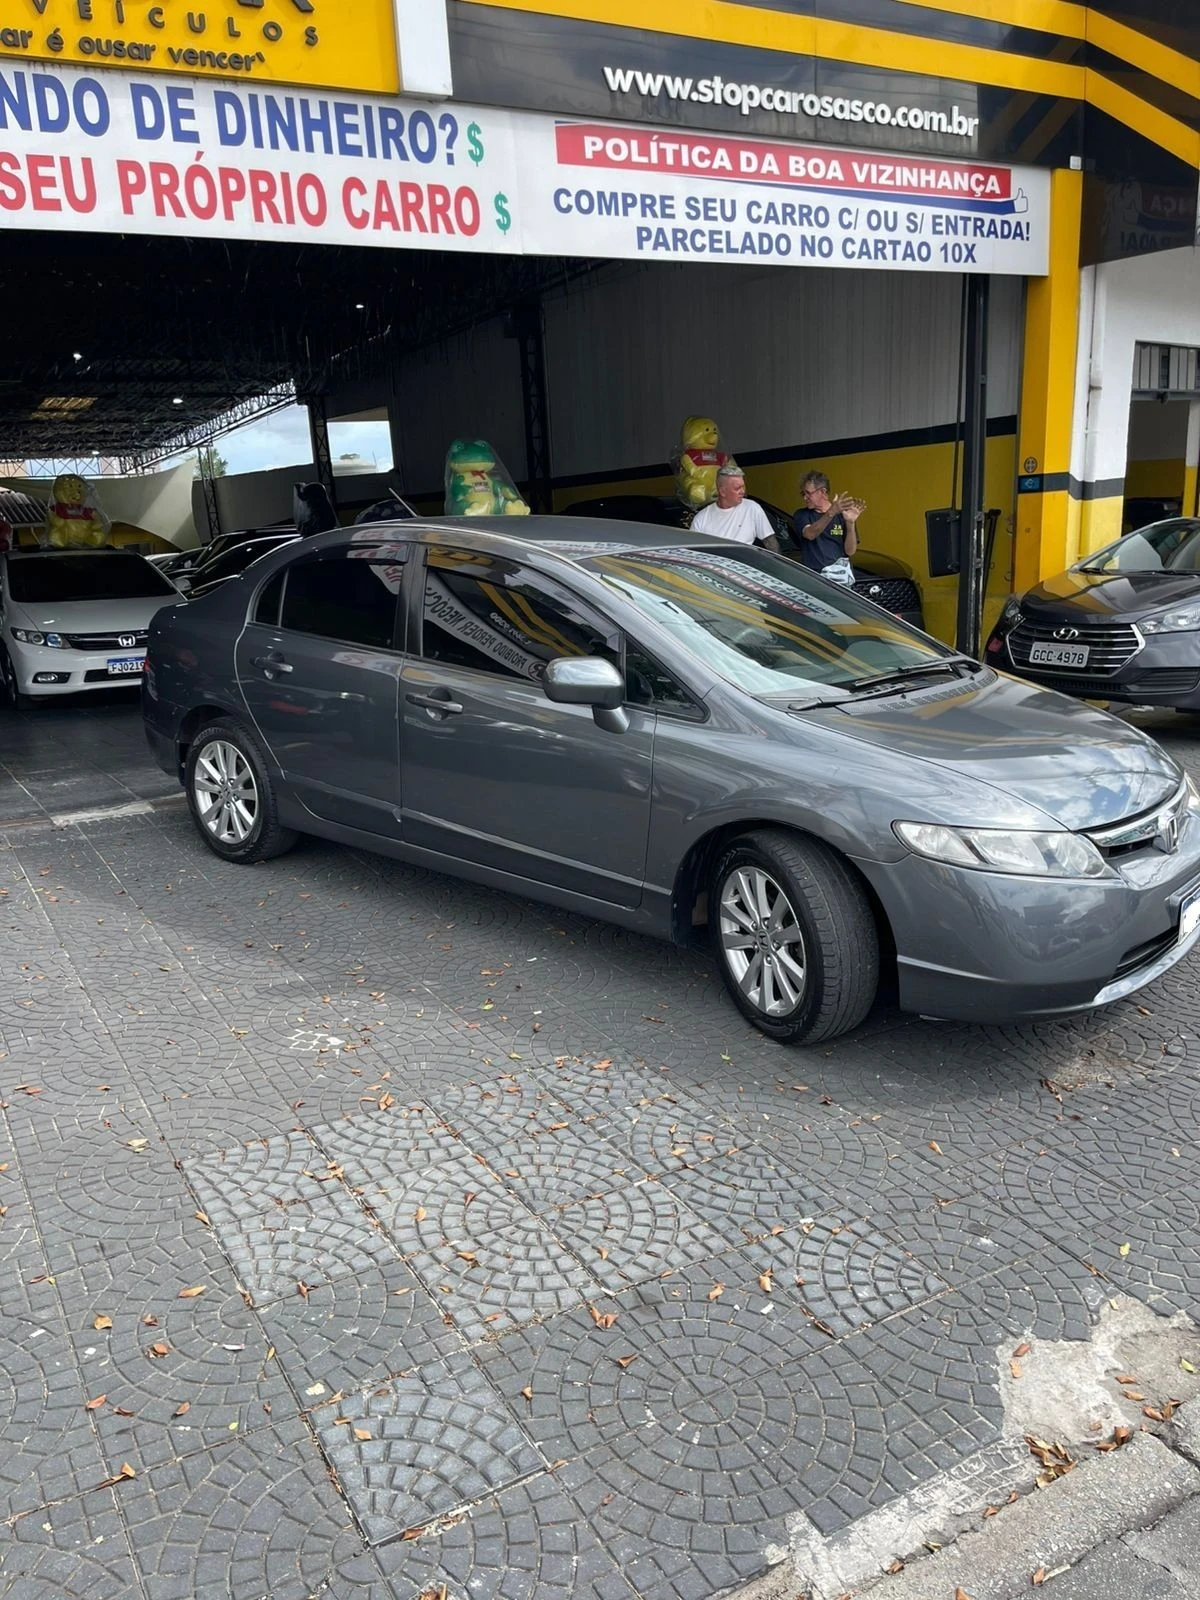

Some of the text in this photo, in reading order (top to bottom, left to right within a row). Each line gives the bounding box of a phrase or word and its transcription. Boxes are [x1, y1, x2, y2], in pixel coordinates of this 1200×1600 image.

[46, 28, 64, 51] é
[79, 36, 156, 61] ousar
[0, 71, 110, 137] NDO
[130, 83, 200, 144] DE
[213, 90, 459, 166] DINHEIRO?
[603, 66, 979, 137] www.stopcarosasco.com.br
[0, 151, 97, 213] SEU
[116, 151, 328, 227] PRÓPRIO
[342, 177, 481, 237] CARRO
[584, 135, 1001, 197] POLÍTICA DA BOA VIZINHANÇA
[553, 188, 1031, 242] COMPRE SEU CARRO C/ OU S/ ENTRADA!
[636, 226, 977, 264] PARCELADO NO CARTAO 10X
[1033, 650, 1084, 664] GCC-4978
